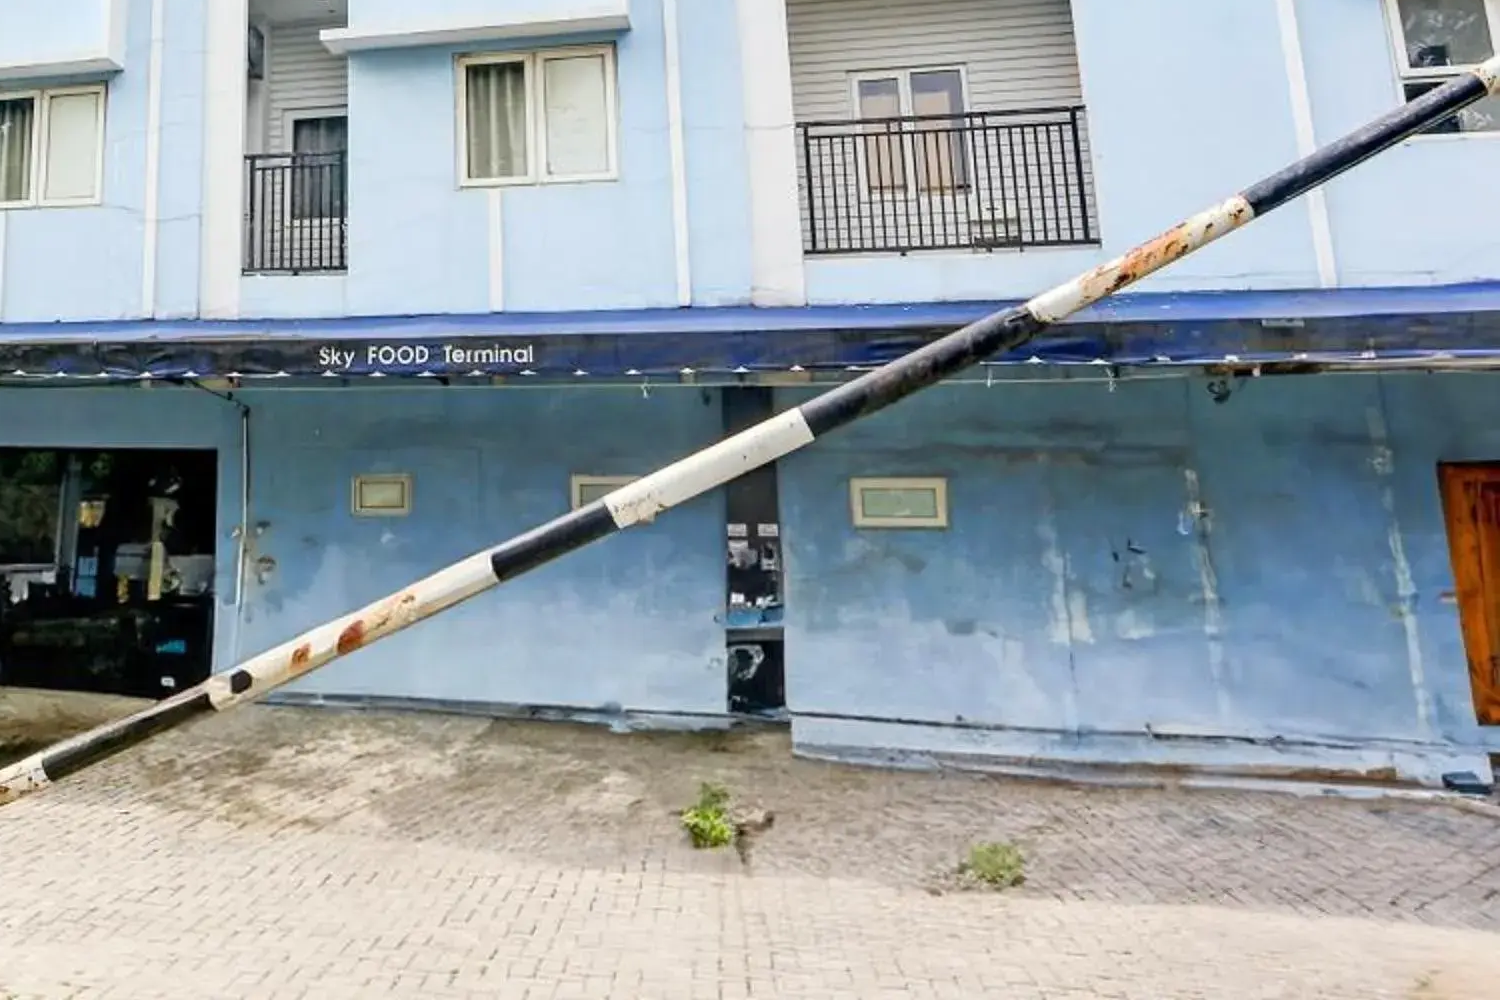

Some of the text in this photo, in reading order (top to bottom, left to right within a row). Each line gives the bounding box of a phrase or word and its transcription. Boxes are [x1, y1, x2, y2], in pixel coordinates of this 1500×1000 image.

[319, 345, 534, 368] Sky FOOD Terminal
